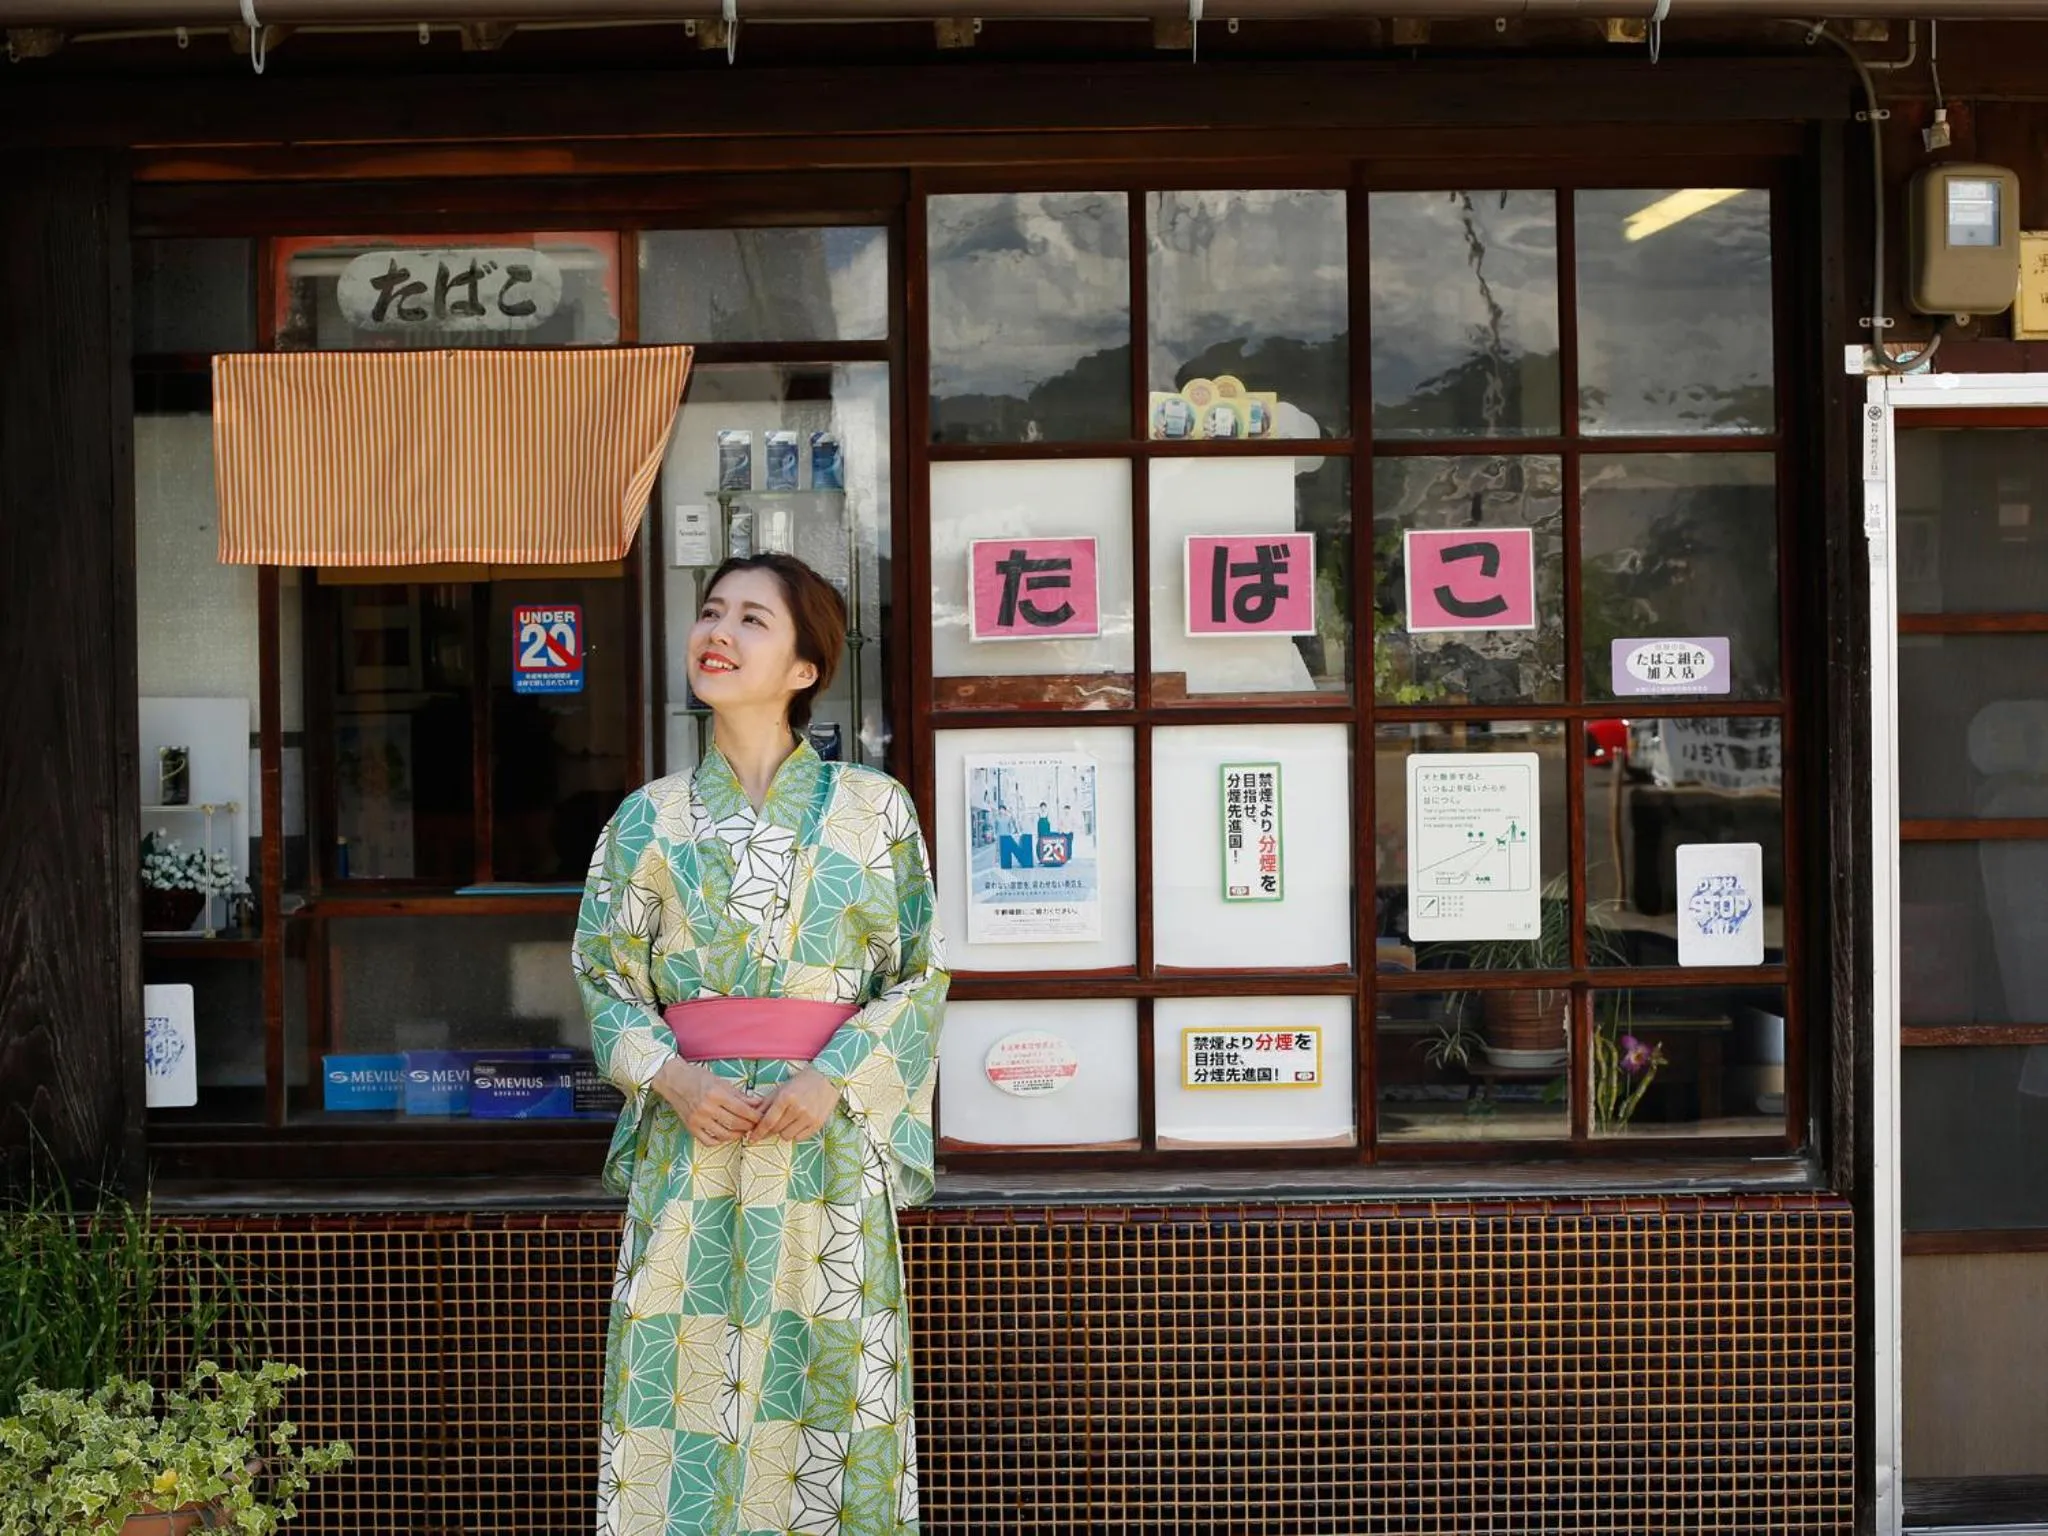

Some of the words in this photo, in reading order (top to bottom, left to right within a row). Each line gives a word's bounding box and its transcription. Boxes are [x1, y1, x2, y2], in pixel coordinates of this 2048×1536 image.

[370, 258, 537, 322] たばこ
[995, 549, 1075, 628] た
[1211, 543, 1292, 624] ば
[1433, 541, 1508, 618] こ
[519, 611, 576, 623] UNDER
[520, 623, 576, 667] 20
[1637, 651, 1705, 666] たばこ組合
[1647, 666, 1695, 679] 加入店
[1243, 773, 1257, 822] 目指せ、
[1227, 773, 1242, 864] 分煙先進国！
[1258, 773, 1276, 892] 禁煙より分煙を
[1193, 1033, 1312, 1050] 禁煙より分煙を
[1194, 1052, 1245, 1066] 目指せ、
[493, 1077, 544, 1088] MEVIUS
[1194, 1068, 1279, 1082] 分煙先進国！
